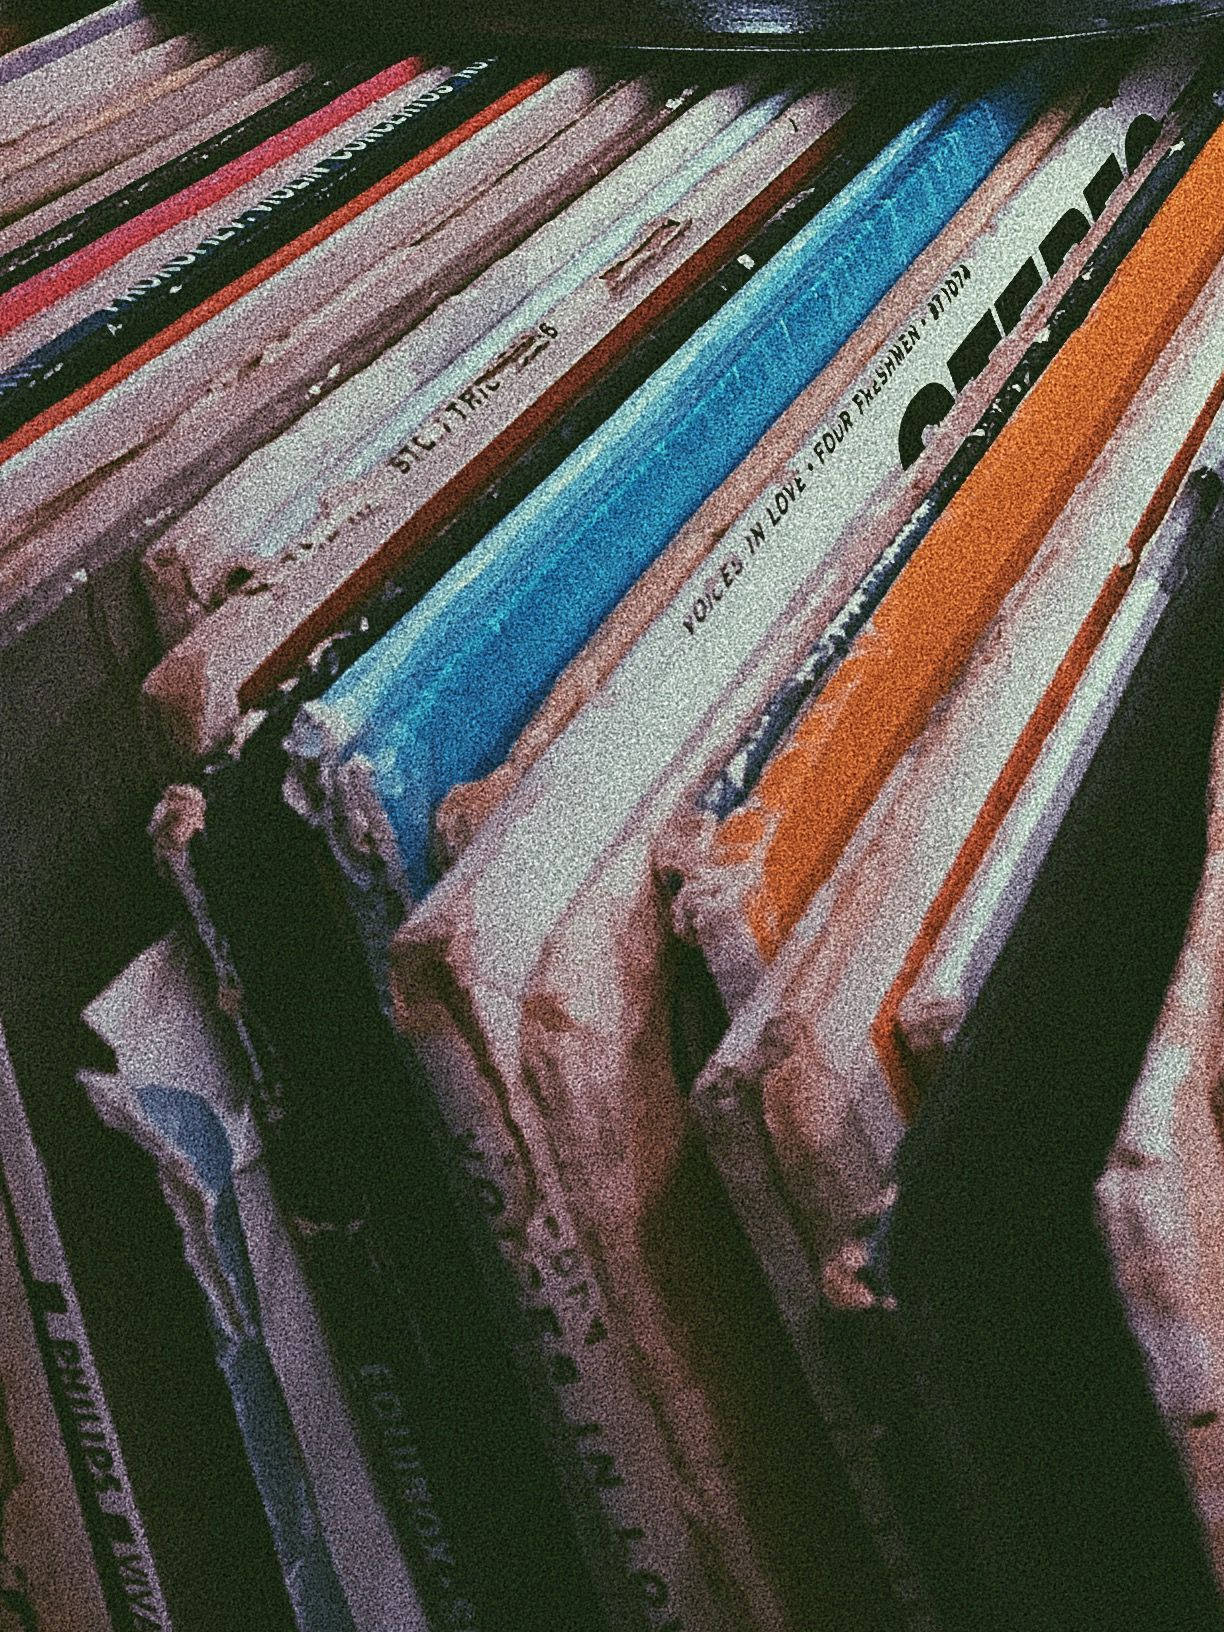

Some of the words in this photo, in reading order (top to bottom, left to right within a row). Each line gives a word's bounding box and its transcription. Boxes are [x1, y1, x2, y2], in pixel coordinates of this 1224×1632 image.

[683, 560, 744, 635] VOICES
[745, 522, 766, 555] IN
[766, 477, 806, 526] LOVE
[812, 410, 853, 465] FOUR
[852, 324, 921, 415] FRESHMEN
[52, 1337, 124, 1494] PHILIPS
